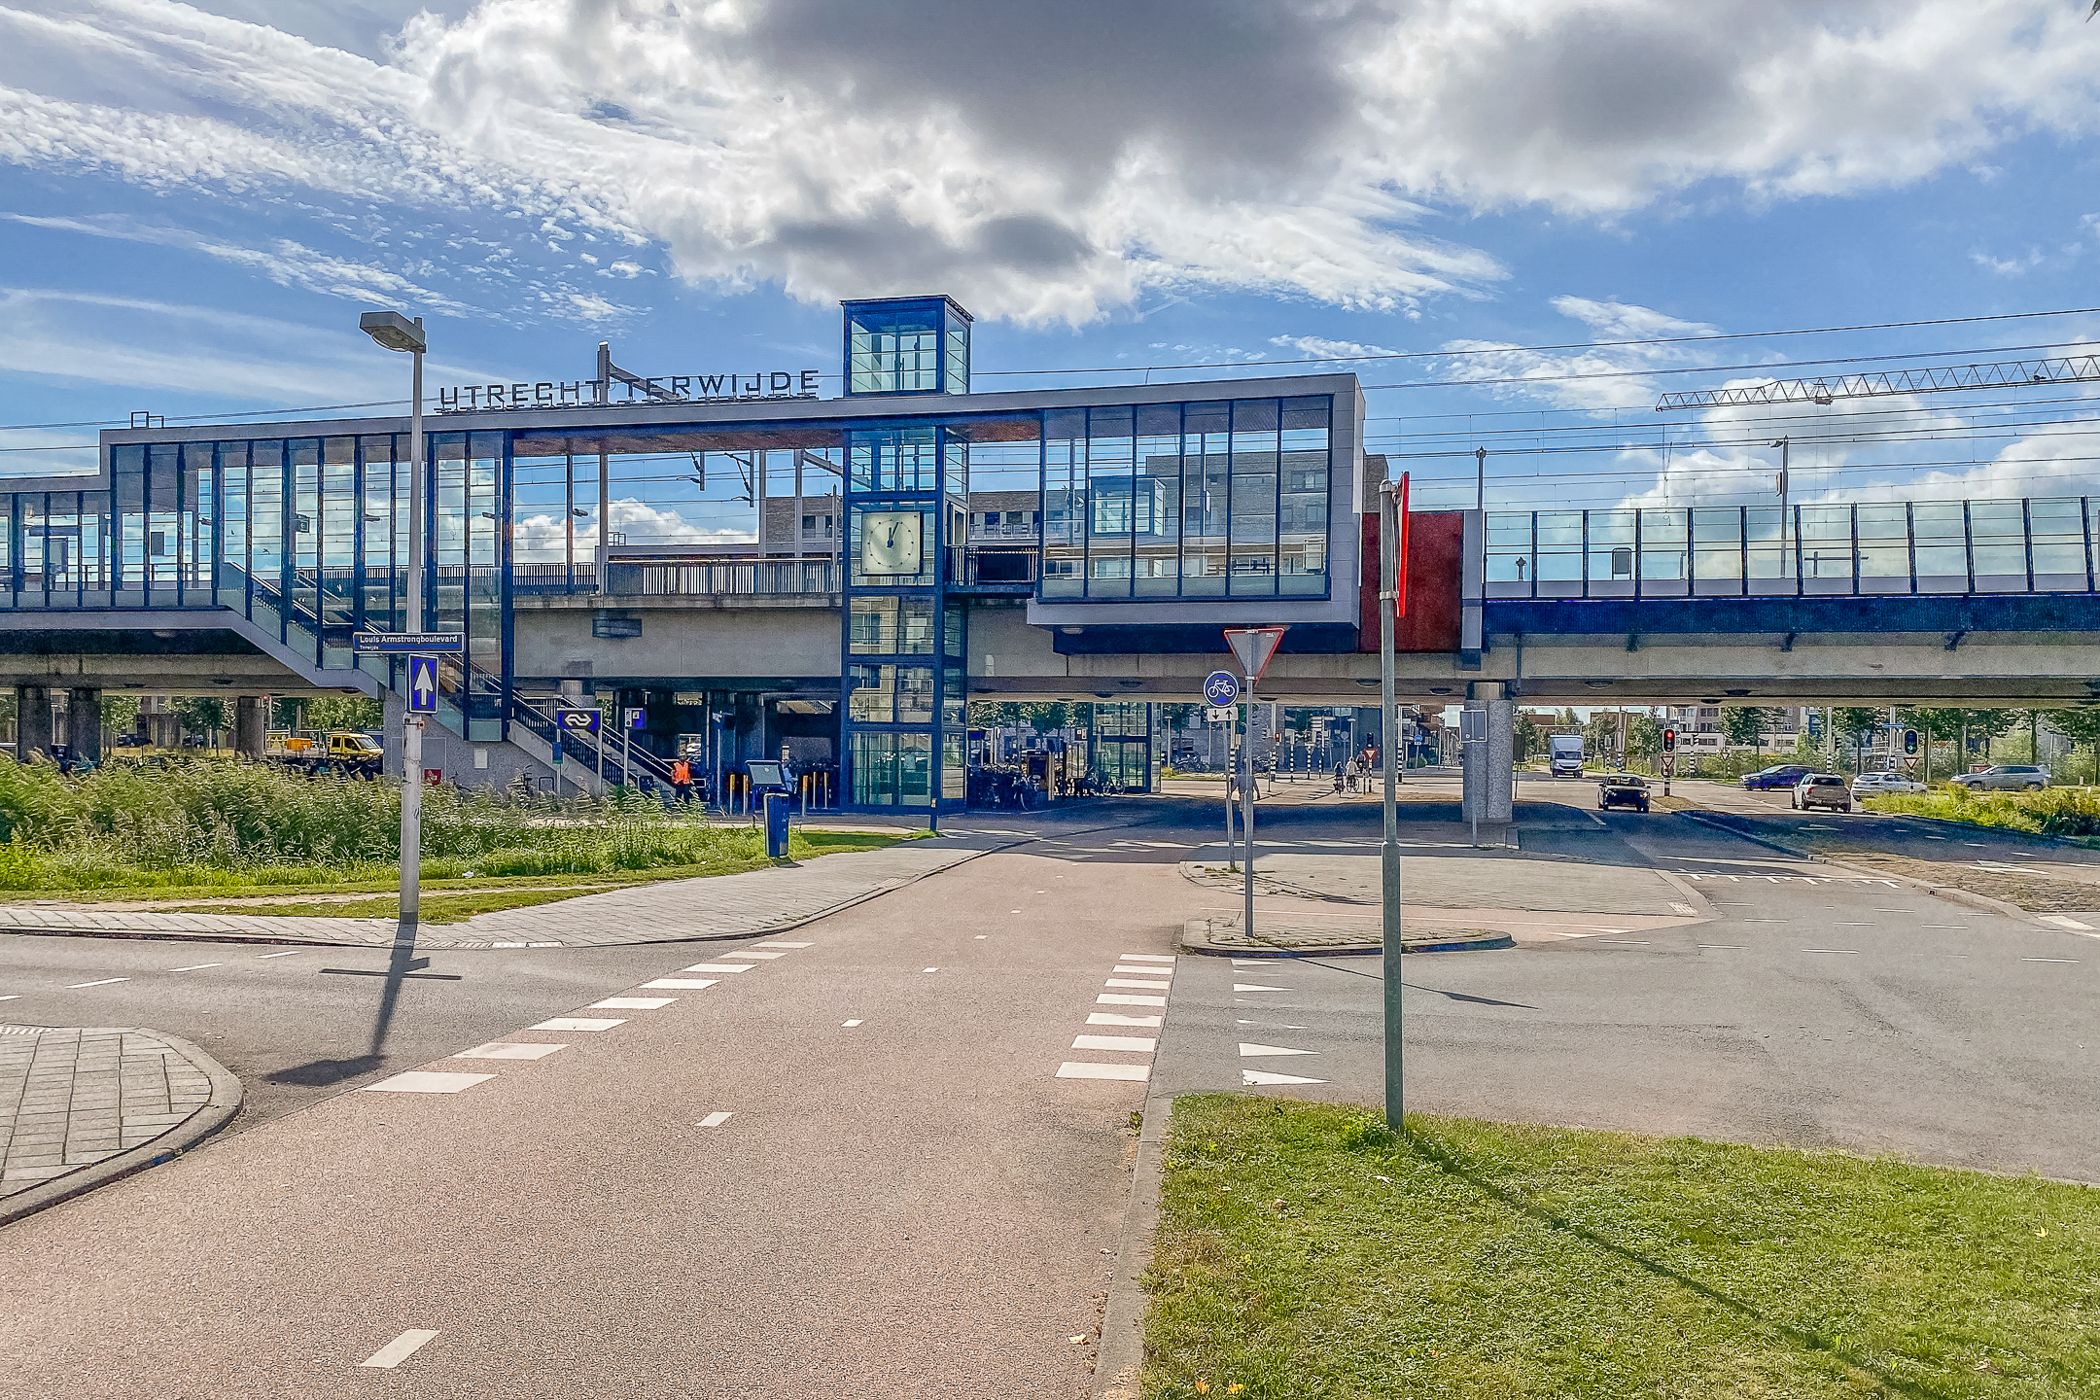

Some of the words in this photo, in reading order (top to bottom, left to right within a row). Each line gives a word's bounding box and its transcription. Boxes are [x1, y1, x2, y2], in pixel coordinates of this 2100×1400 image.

[440, 379, 604, 405] UTRECHT
[621, 369, 819, 399] TERWIJDE
[360, 635, 380, 643] Louis
[381, 635, 458, 645] Armstrongboulevard
